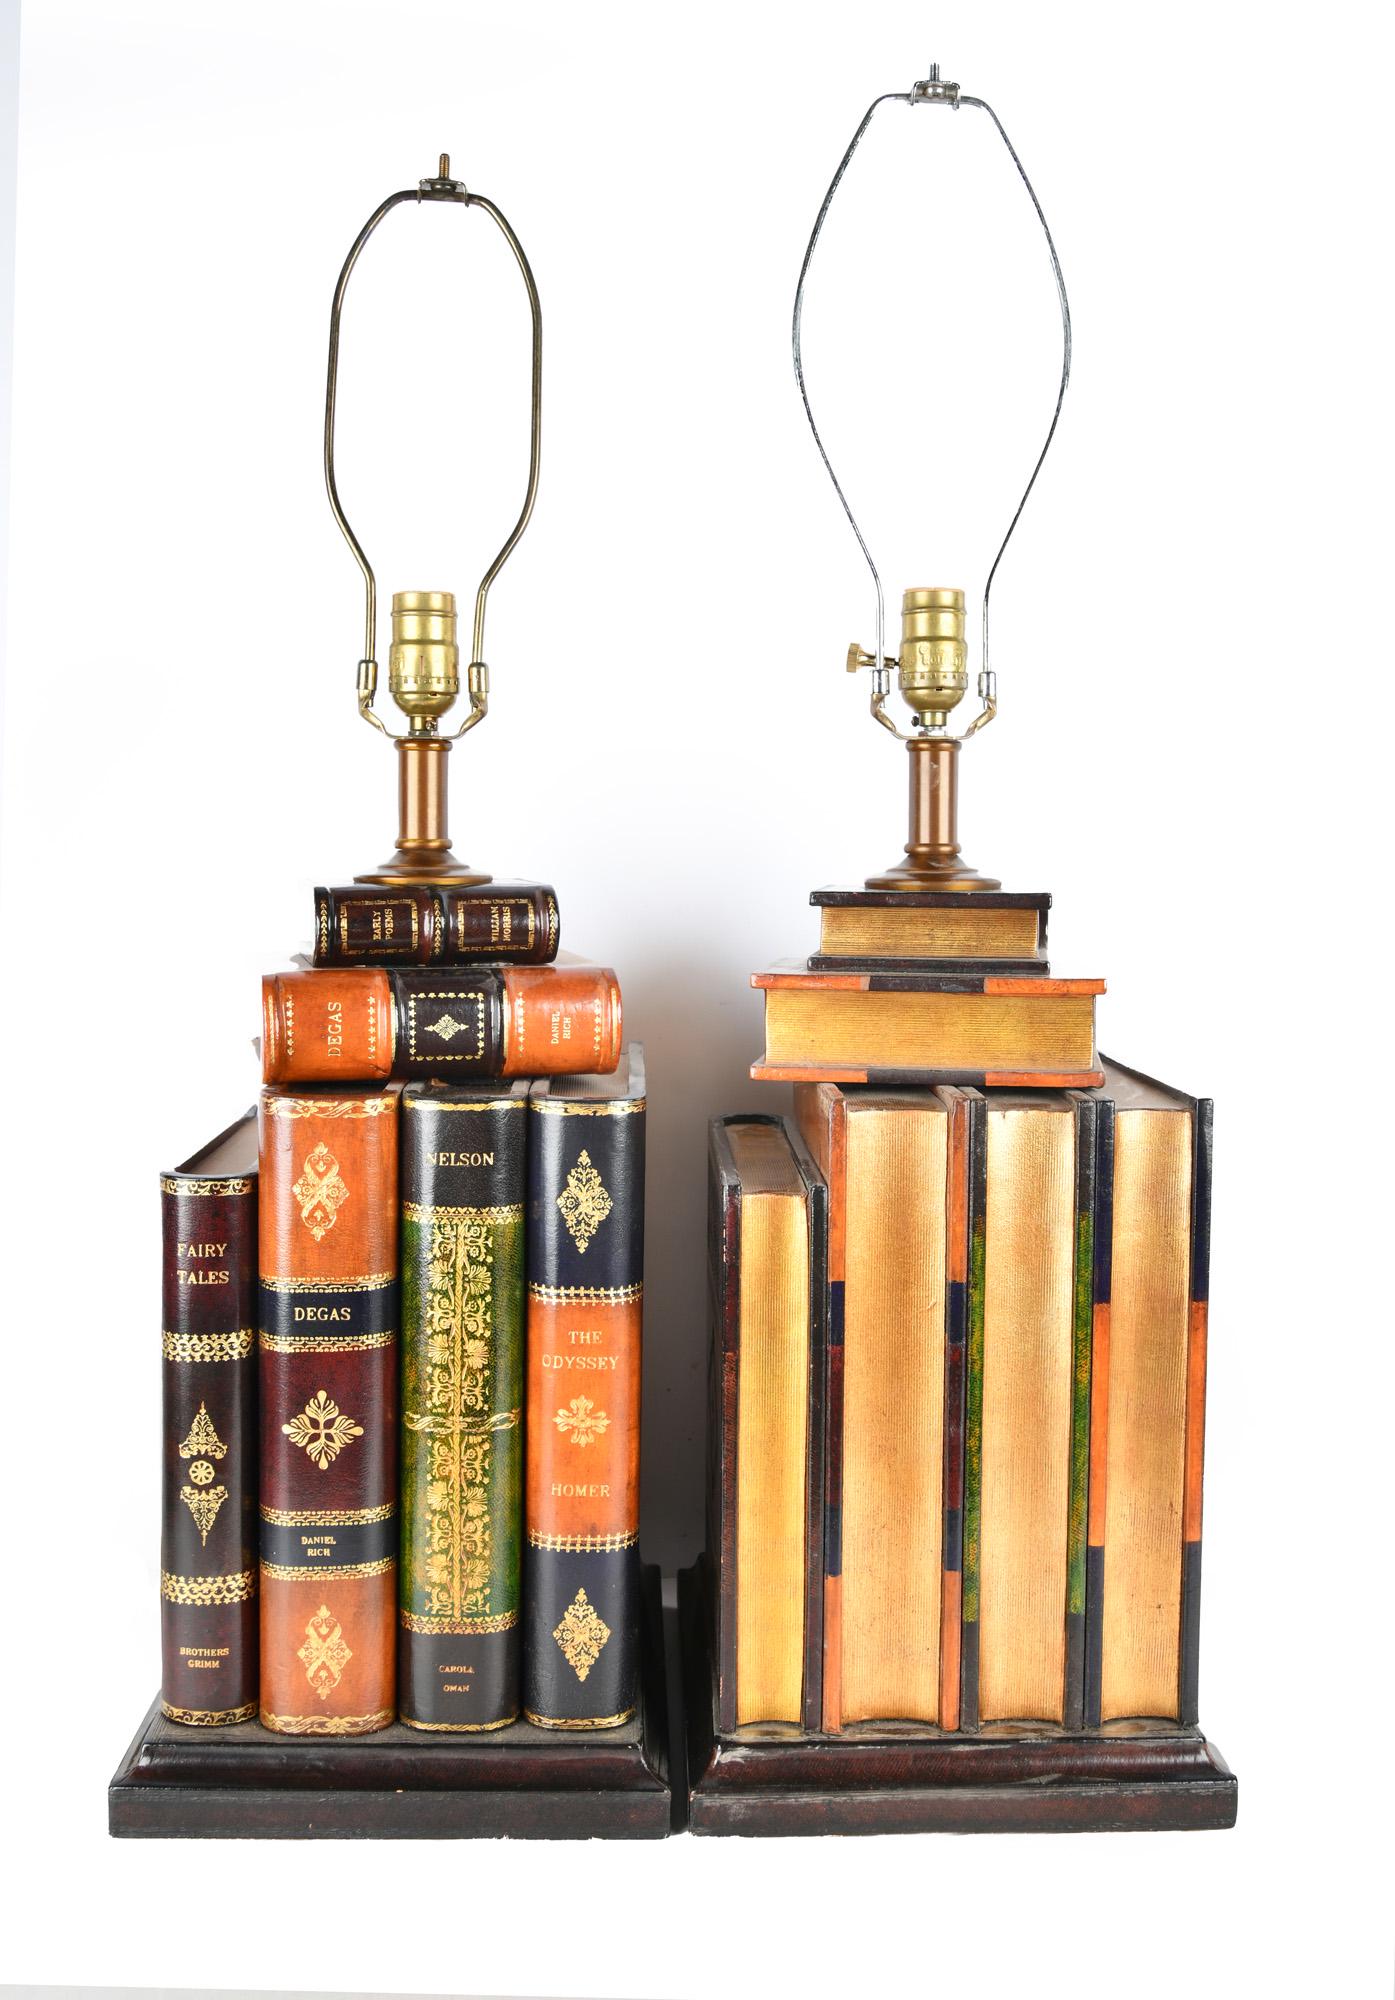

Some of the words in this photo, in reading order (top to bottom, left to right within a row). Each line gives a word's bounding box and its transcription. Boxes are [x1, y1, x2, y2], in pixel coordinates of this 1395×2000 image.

[373, 911, 381, 941] EARLY
[385, 908, 393, 940] POEMS
[491, 906, 500, 942] WILLIAM
[503, 906, 512, 941] MORRIS
[327, 1000, 342, 1057] DEGAS
[551, 1010, 560, 1044] DANIEL
[563, 1017, 571, 1039] RICH
[426, 1152, 494, 1166] NELSON
[177, 1243, 227, 1257] FAIRY
[177, 1270, 229, 1284] TALES
[294, 1307, 351, 1321] DEGAS
[568, 1330, 602, 1344] THE
[542, 1354, 619, 1370] ODYSSEY
[551, 1483, 610, 1497] HOMER
[301, 1536, 336, 1544] DANIEL
[307, 1548, 330, 1556] RICH
[180, 1647, 229, 1656] BROTHERS
[188, 1660, 219, 1668] GRIMM
[439, 1665, 474, 1673] CAROLA
